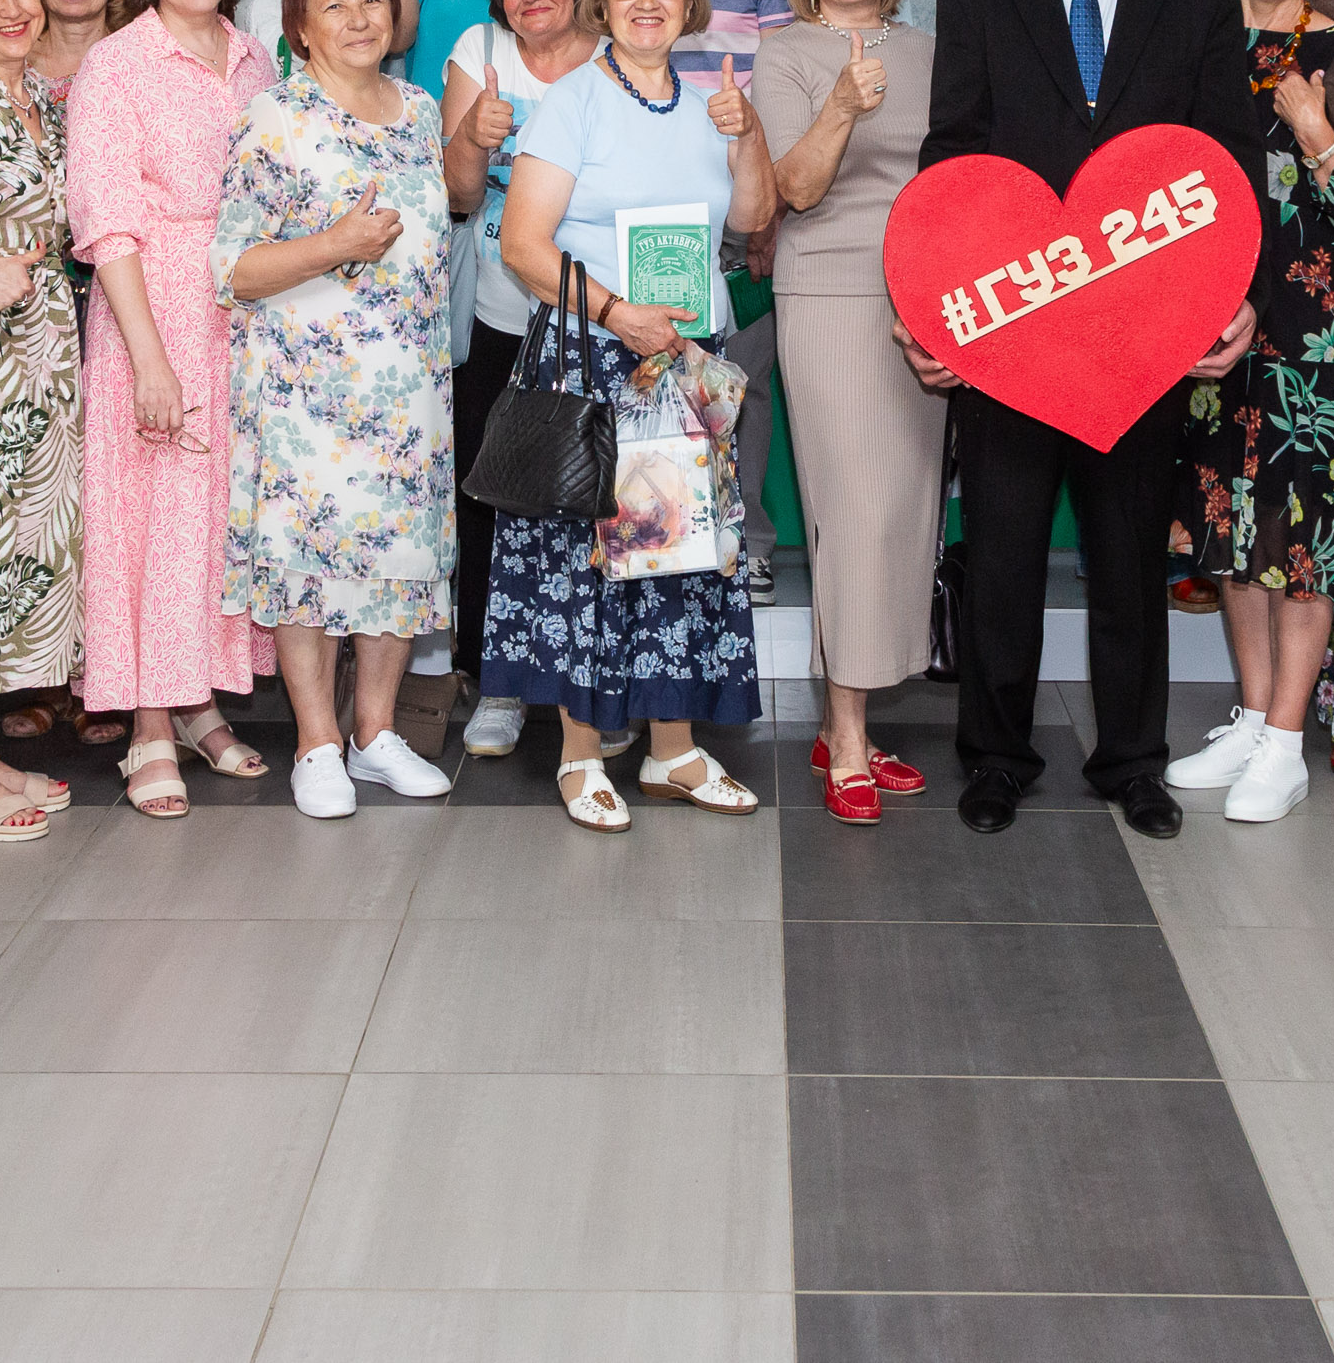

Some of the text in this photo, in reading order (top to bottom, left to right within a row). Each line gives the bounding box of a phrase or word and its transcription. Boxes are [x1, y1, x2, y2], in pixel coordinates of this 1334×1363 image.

[638, 235, 702, 253] ГУЗ АКТИВИТИ
[1099, 169, 1219, 265] 245
